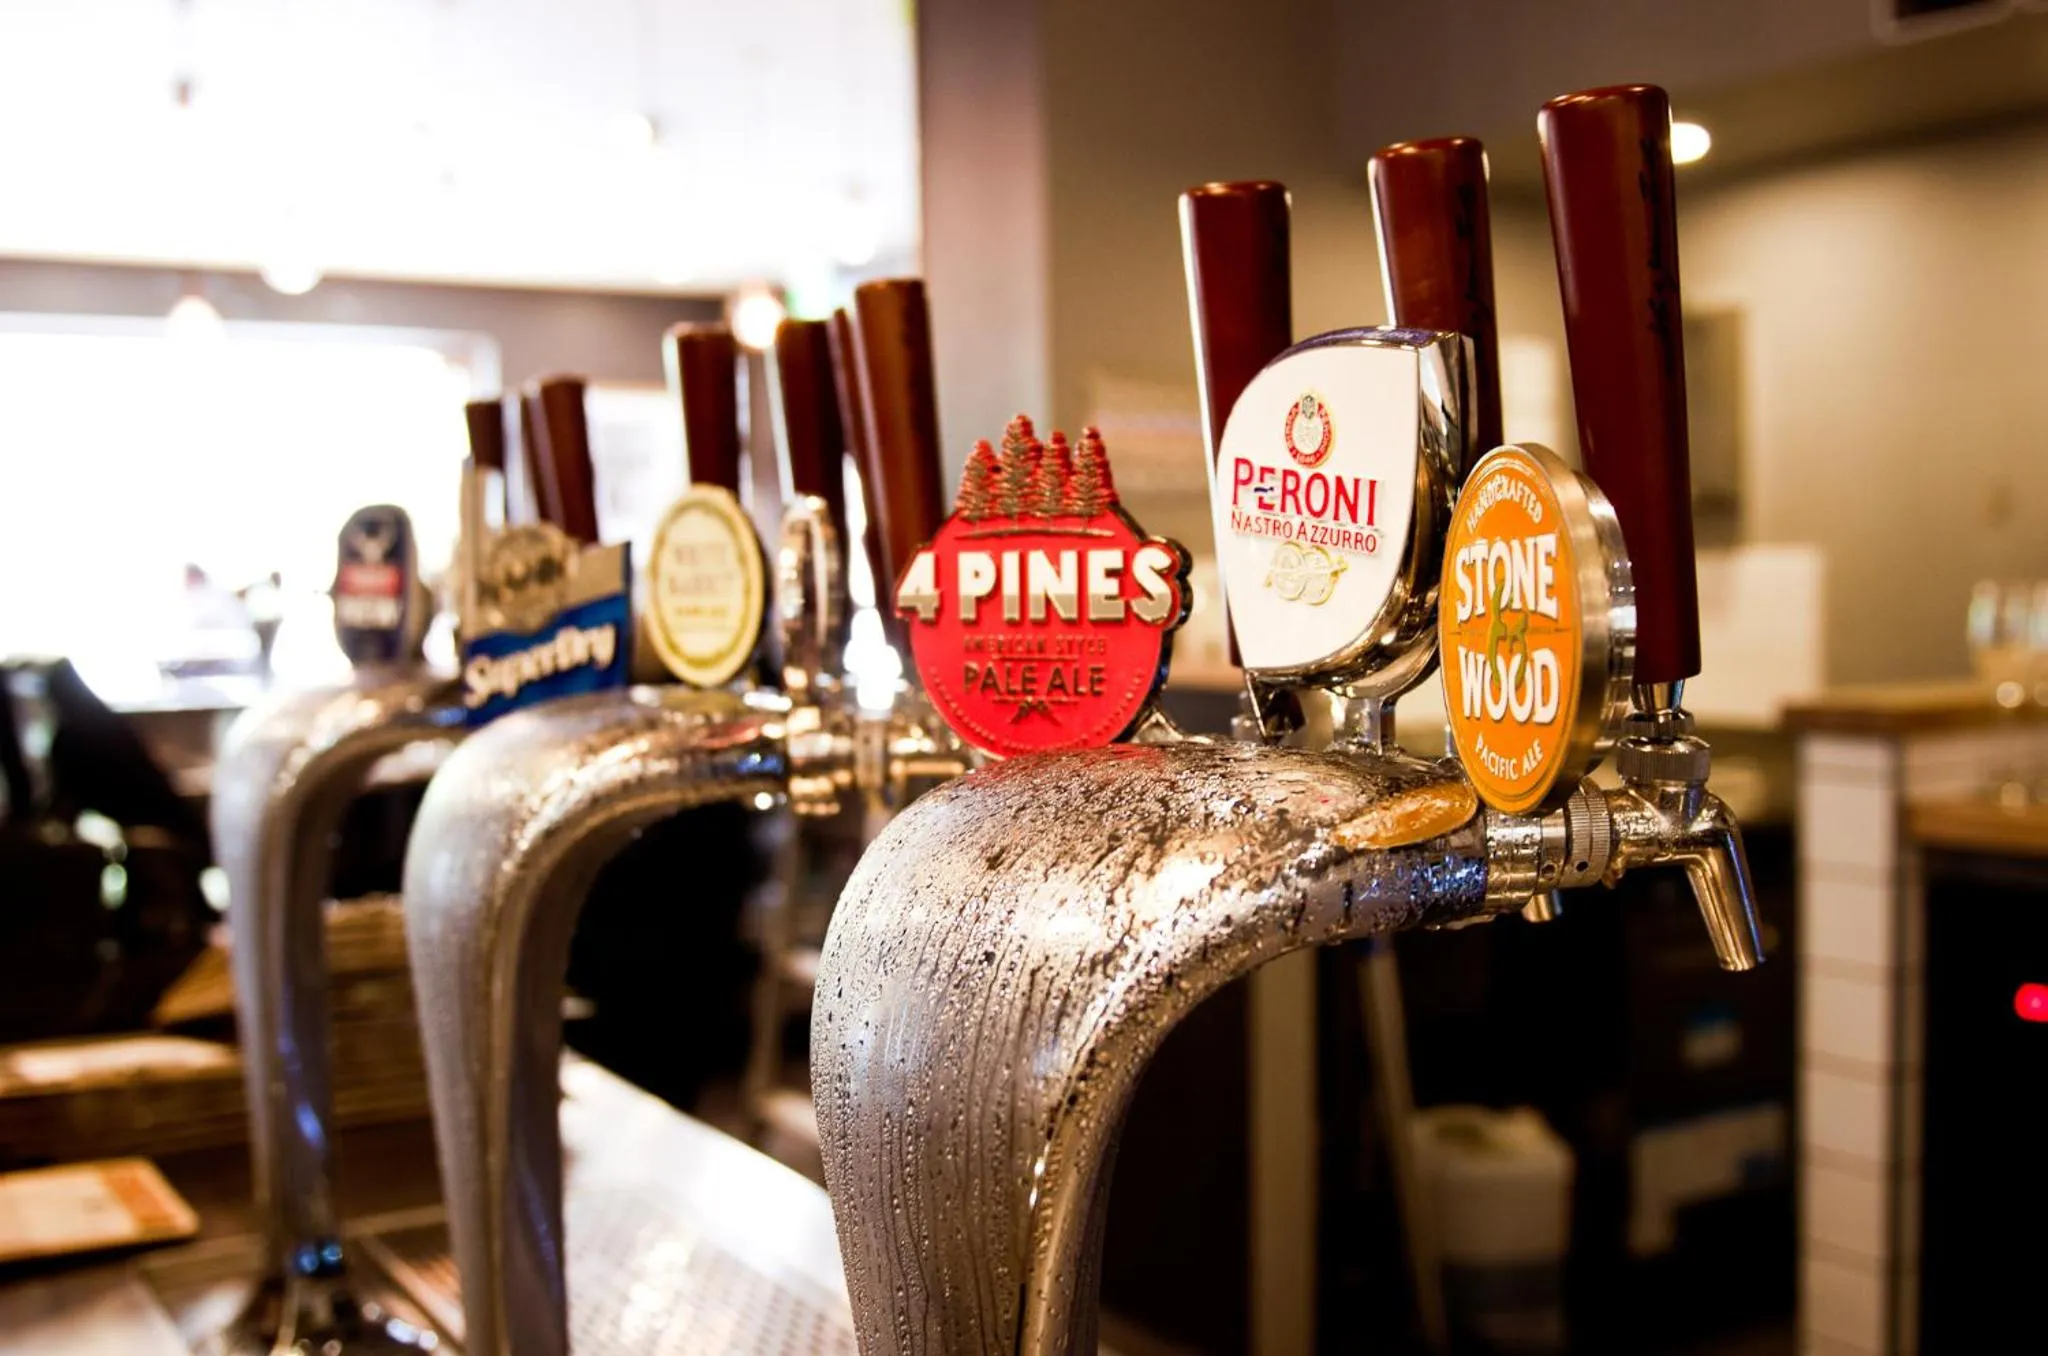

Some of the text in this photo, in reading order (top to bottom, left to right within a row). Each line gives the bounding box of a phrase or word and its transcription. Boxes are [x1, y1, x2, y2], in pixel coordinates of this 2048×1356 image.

[1232, 457, 1377, 526] PERONI
[1466, 474, 1543, 535] HANDCRAFTED
[1231, 510, 1377, 553] NASTRO AZZURRO
[896, 546, 1173, 625] 4 PINES
[1455, 532, 1560, 623] STONE
[963, 662, 1106, 697] PALE ALE
[1458, 645, 1561, 725] WOOD
[1475, 731, 1543, 780] PACIFIC ALE
